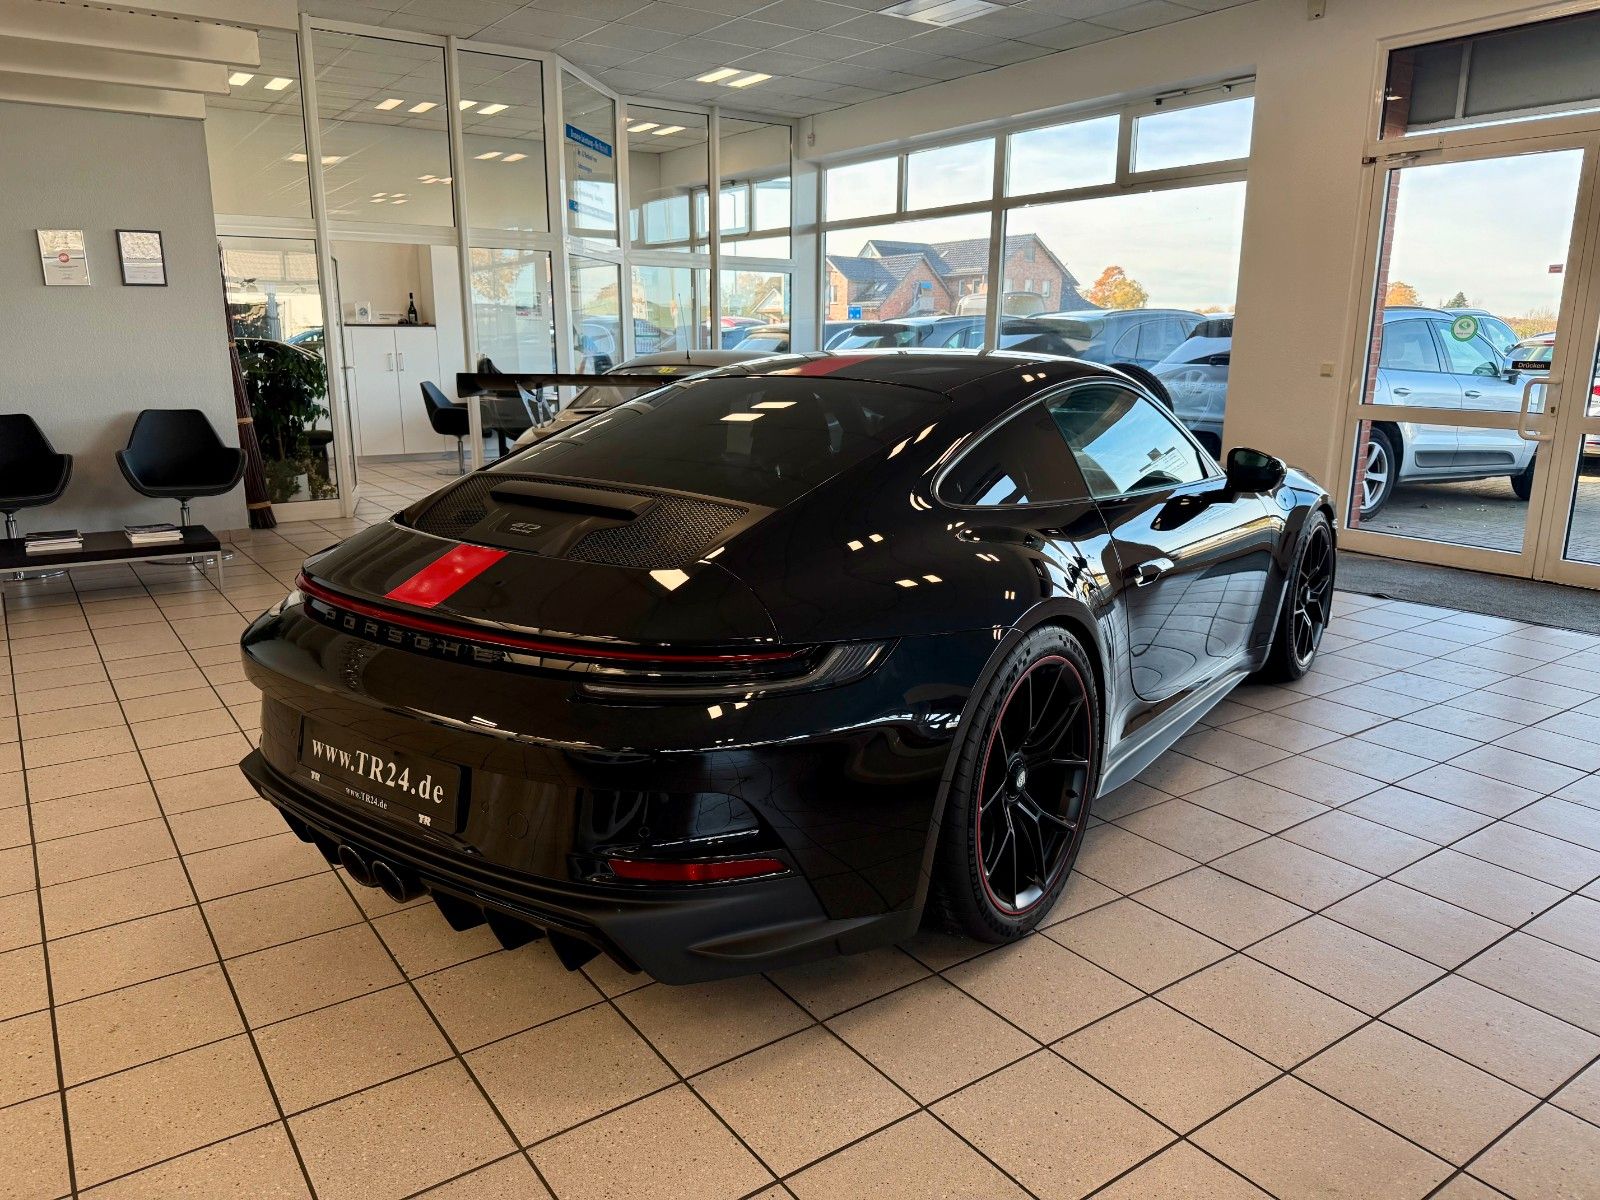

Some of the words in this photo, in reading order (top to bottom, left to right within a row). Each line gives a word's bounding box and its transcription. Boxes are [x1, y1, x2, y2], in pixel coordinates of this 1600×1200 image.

[1517, 361, 1545, 370] Drücken
[325, 608, 503, 662] PORSCHE
[310, 770, 321, 782] TR
[312, 739, 444, 804] www.TR24.de
[345, 787, 388, 810] www.TR24.de
[418, 814, 431, 827] TR
